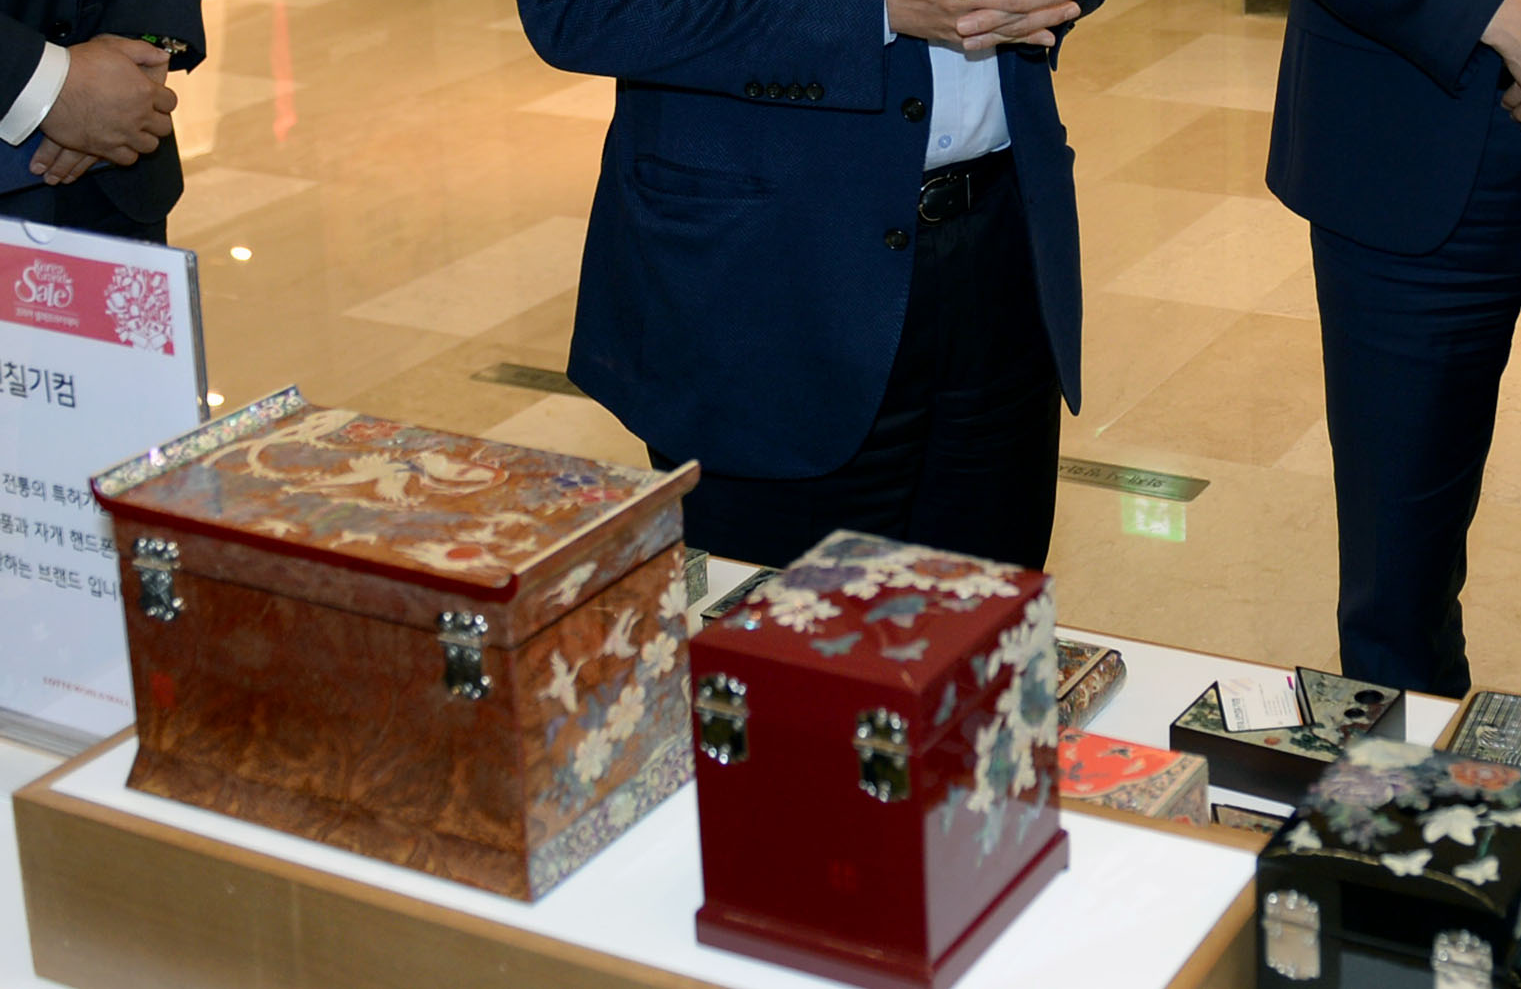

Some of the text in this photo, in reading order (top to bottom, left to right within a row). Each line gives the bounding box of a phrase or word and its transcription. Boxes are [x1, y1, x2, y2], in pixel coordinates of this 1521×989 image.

[15, 266, 74, 308] Sale
[0, 361, 76, 408] 칠기컴
[2, 473, 47, 501] 전통의
[34, 521, 64, 547] 자개
[38, 563, 83, 591] 브랜드
